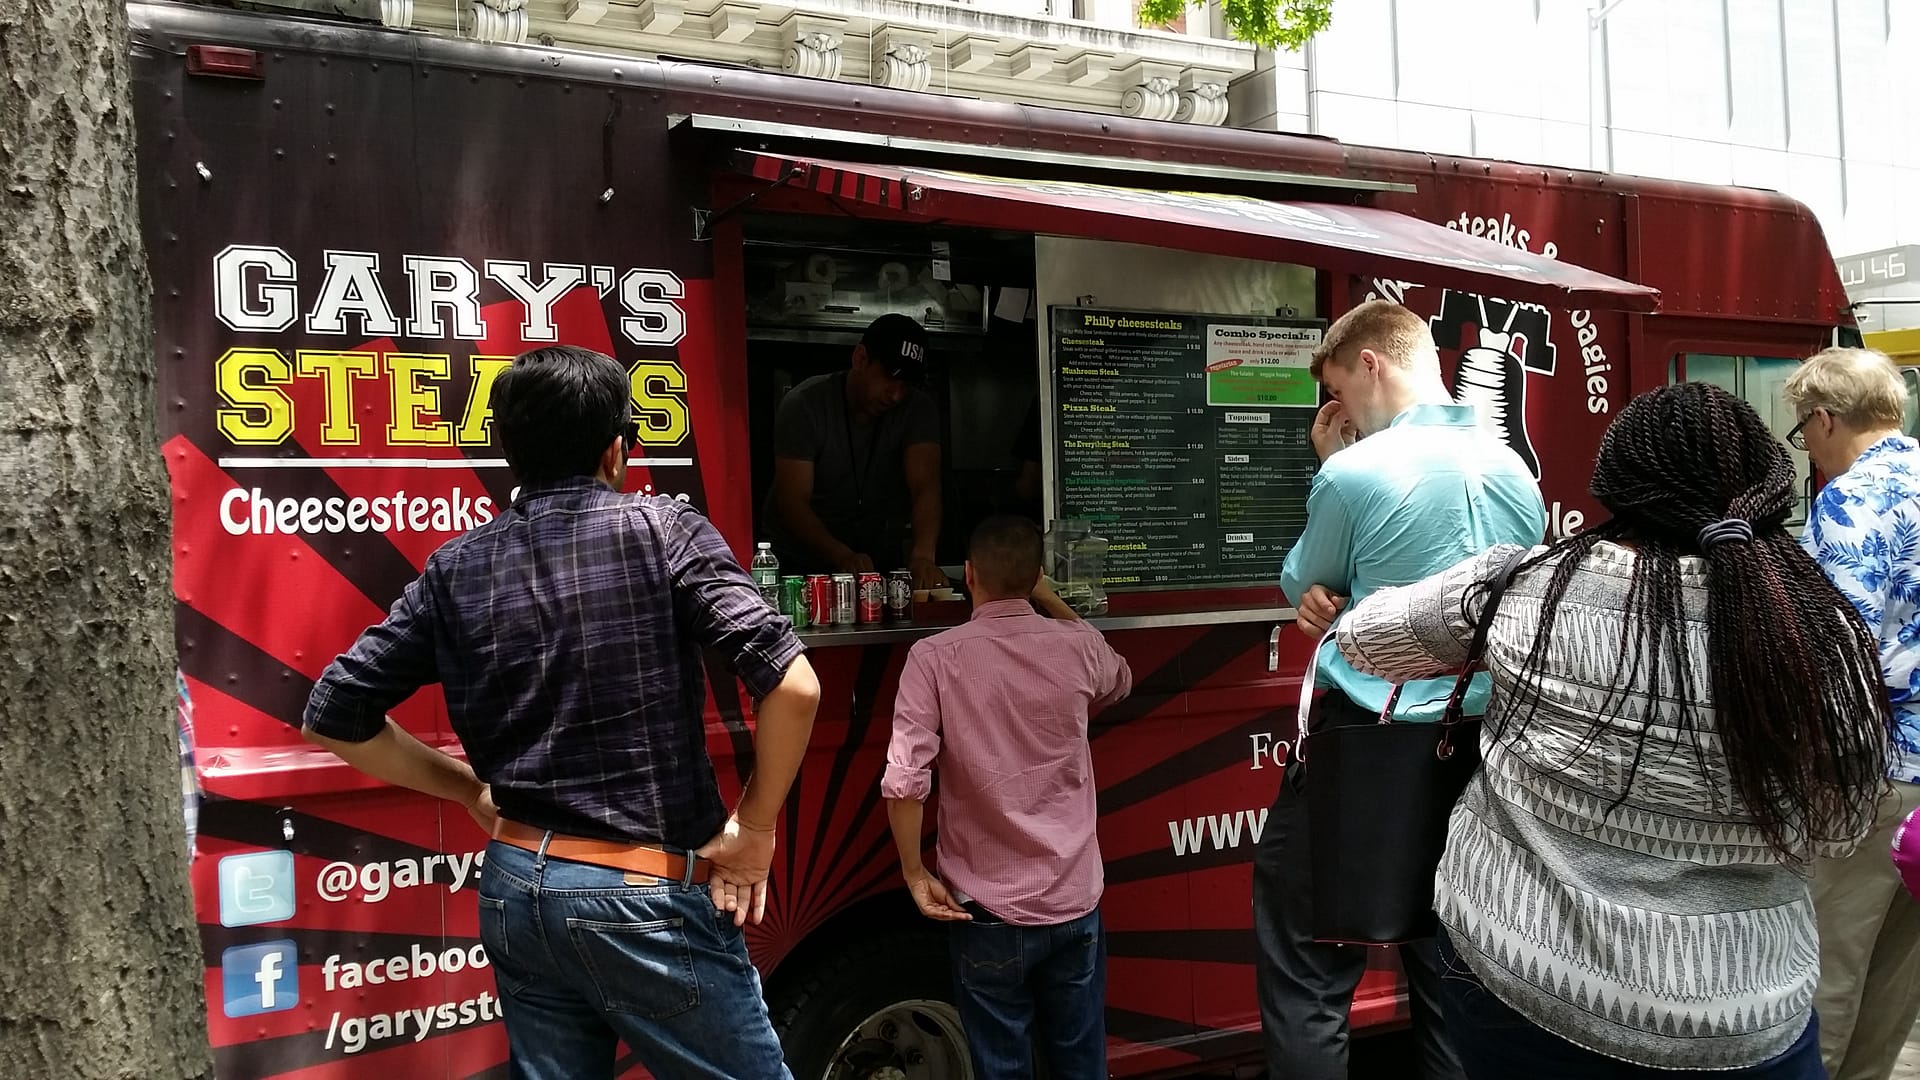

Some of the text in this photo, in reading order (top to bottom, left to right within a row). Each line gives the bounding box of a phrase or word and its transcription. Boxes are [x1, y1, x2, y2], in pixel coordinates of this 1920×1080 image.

[1871, 253, 1906, 279] 46
[213, 244, 686, 347] GARY'S
[1084, 315, 1182, 330] Philly cheesesteaks
[1215, 329, 1257, 339] Combo
[901, 340, 924, 364] USA
[1061, 337, 1105, 346] Cheesesteak
[1062, 367, 1120, 376] Mushroom Steak
[1567, 309, 1611, 415] oagies
[215, 347, 690, 448] STEAS
[1090, 404, 1117, 412] Steak
[1064, 440, 1076, 448] The
[1076, 440, 1111, 449] Everything
[219, 486, 493, 536] Cheesesteaks
[1545, 501, 1584, 537] le
[1106, 542, 1147, 551] eesesteak
[1102, 576, 1140, 584] parmesan
[1249, 732, 1296, 770] Fo
[321, 943, 491, 992] faceboo
